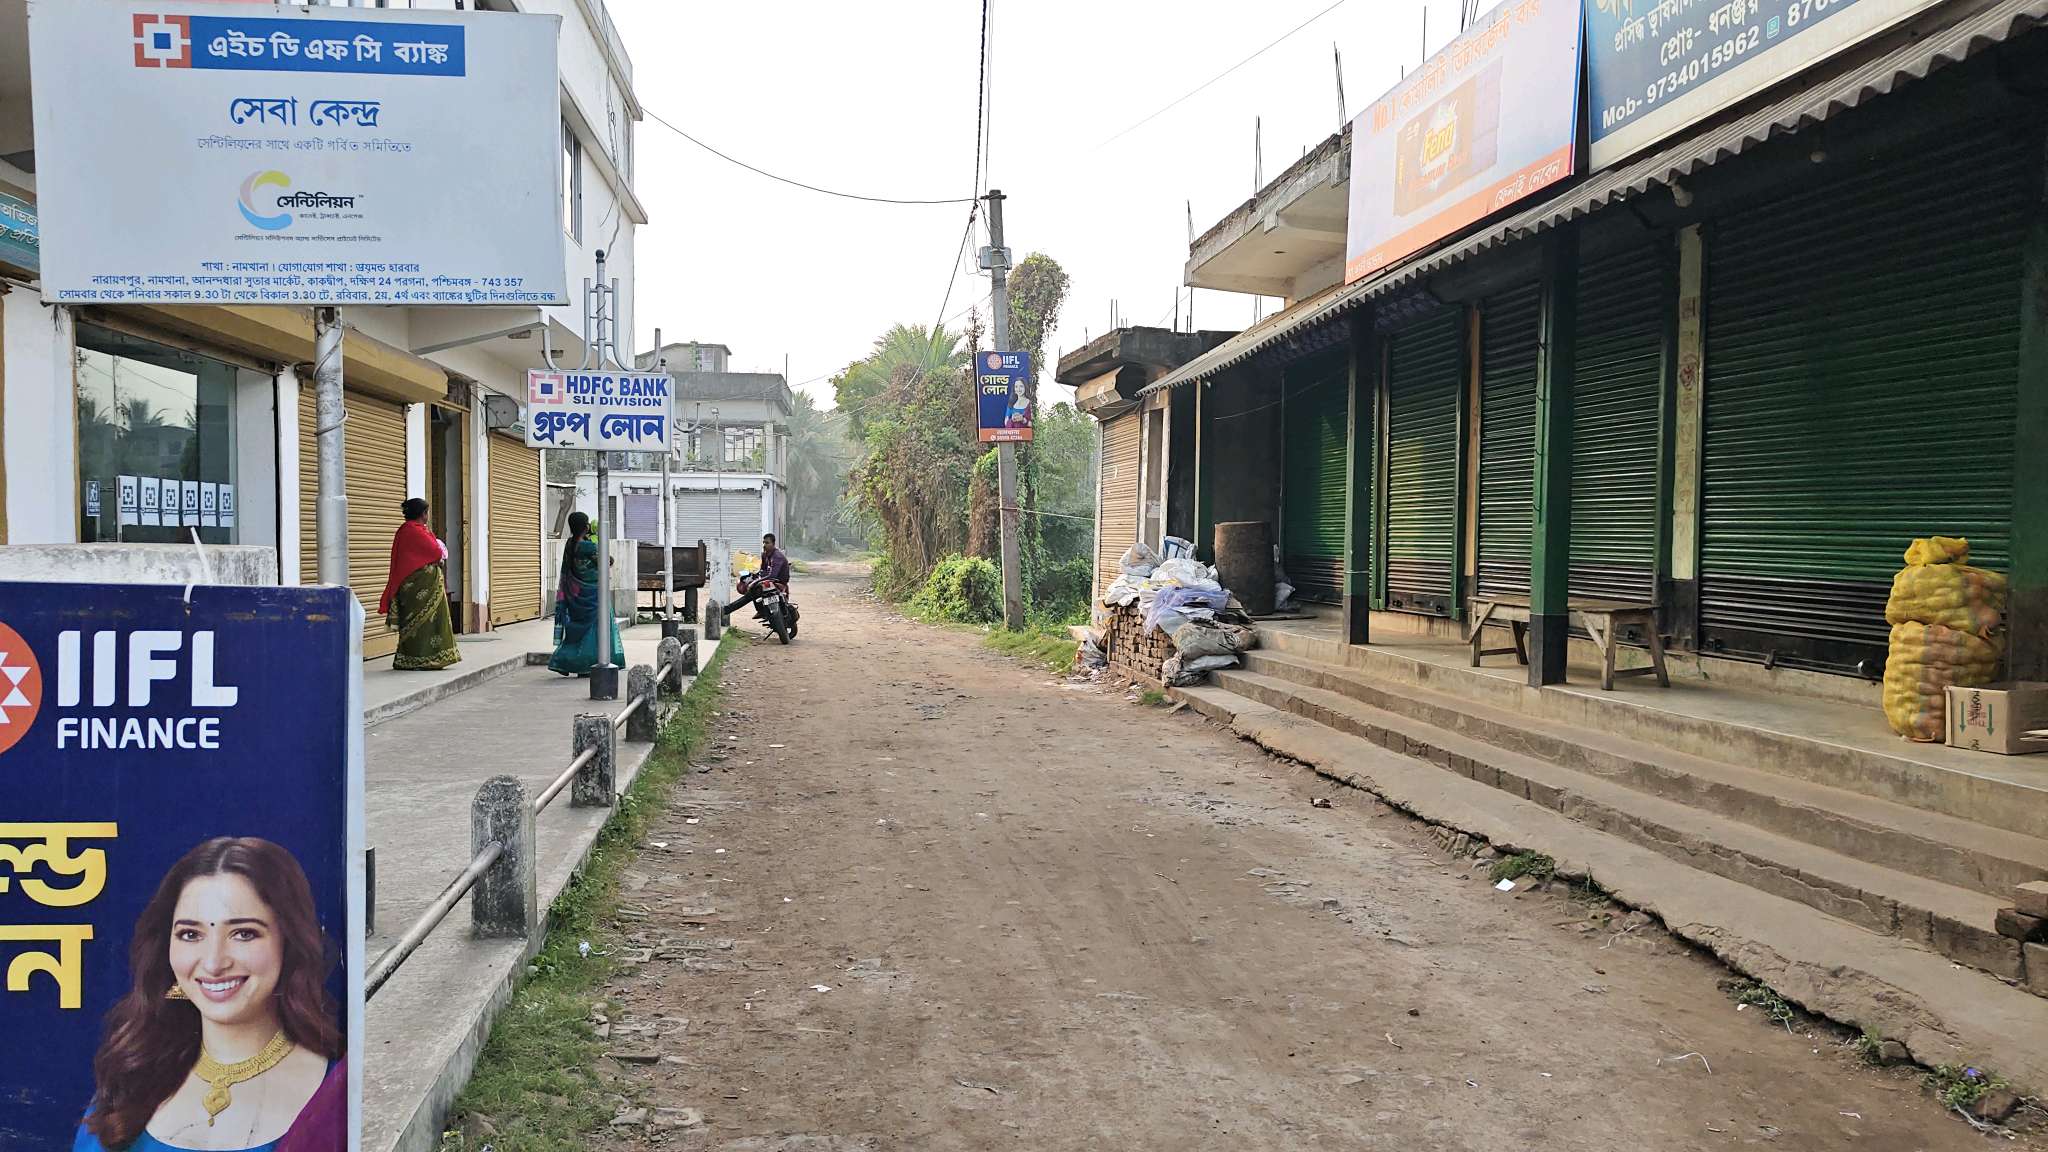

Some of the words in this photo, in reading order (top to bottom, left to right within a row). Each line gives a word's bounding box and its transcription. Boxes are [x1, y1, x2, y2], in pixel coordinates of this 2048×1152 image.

[208, 29, 266, 58] এইচ
[269, 31, 300, 59] ডি
[304, 38, 349, 61] এফ
[353, 34, 383, 62] সি
[393, 40, 449, 65] ব্যাঙ্ক
[1603, 97, 1642, 129] Mob-
[1647, 25, 1760, 103] 9734015962
[230, 96, 298, 126] সেবা
[309, 99, 380, 127] কেন্দ্র
[266, 138, 289, 151] সাথে
[294, 136, 324, 151] একটি
[327, 137, 358, 151] গর্বিত
[277, 191, 355, 209] সেন্টিলিয়ন
[202, 262, 223, 272] শাখা
[232, 262, 268, 272] নামখানা
[278, 262, 323, 272] যোগাযোগ
[326, 263, 347, 272] শাখা
[389, 263, 420, 272] হারবার
[350, 274, 376, 286] দক্ষিণ
[379, 276, 391, 286] 24
[431, 274, 471, 287] পশ্চিমবঙ্গ
[482, 277, 502, 287] 743
[504, 278, 524, 287] 357
[59, 289, 97, 299] সোমবার
[100, 290, 124, 299] থেকে
[127, 287, 161, 299] শনিবার
[163, 290, 191, 299] সকাল
[194, 290, 219, 299] 9.30
[221, 287, 231, 300] টা
[234, 290, 258, 300] থেকে
[260, 287, 289, 300] বিকাল
[292, 290, 316, 300] 3.30
[411, 291, 430, 300] এবং
[465, 287, 488, 302] ছুটির
[490, 287, 539, 301] দিনগুলিতে
[540, 291, 556, 301] বন্ধ
[1002, 355, 1020, 365] IIFL
[566, 375, 613, 395] HDFC
[620, 377, 667, 397] BANK
[980, 374, 1010, 385] গোল্ড
[983, 385, 1008, 396] লোন
[573, 395, 595, 405] SLI
[600, 396, 662, 407] DIVISION
[533, 411, 591, 445] গ্রুপ
[600, 413, 665, 444] লোন
[57, 630, 238, 707] IIFL
[57, 717, 220, 749] FINANCE
